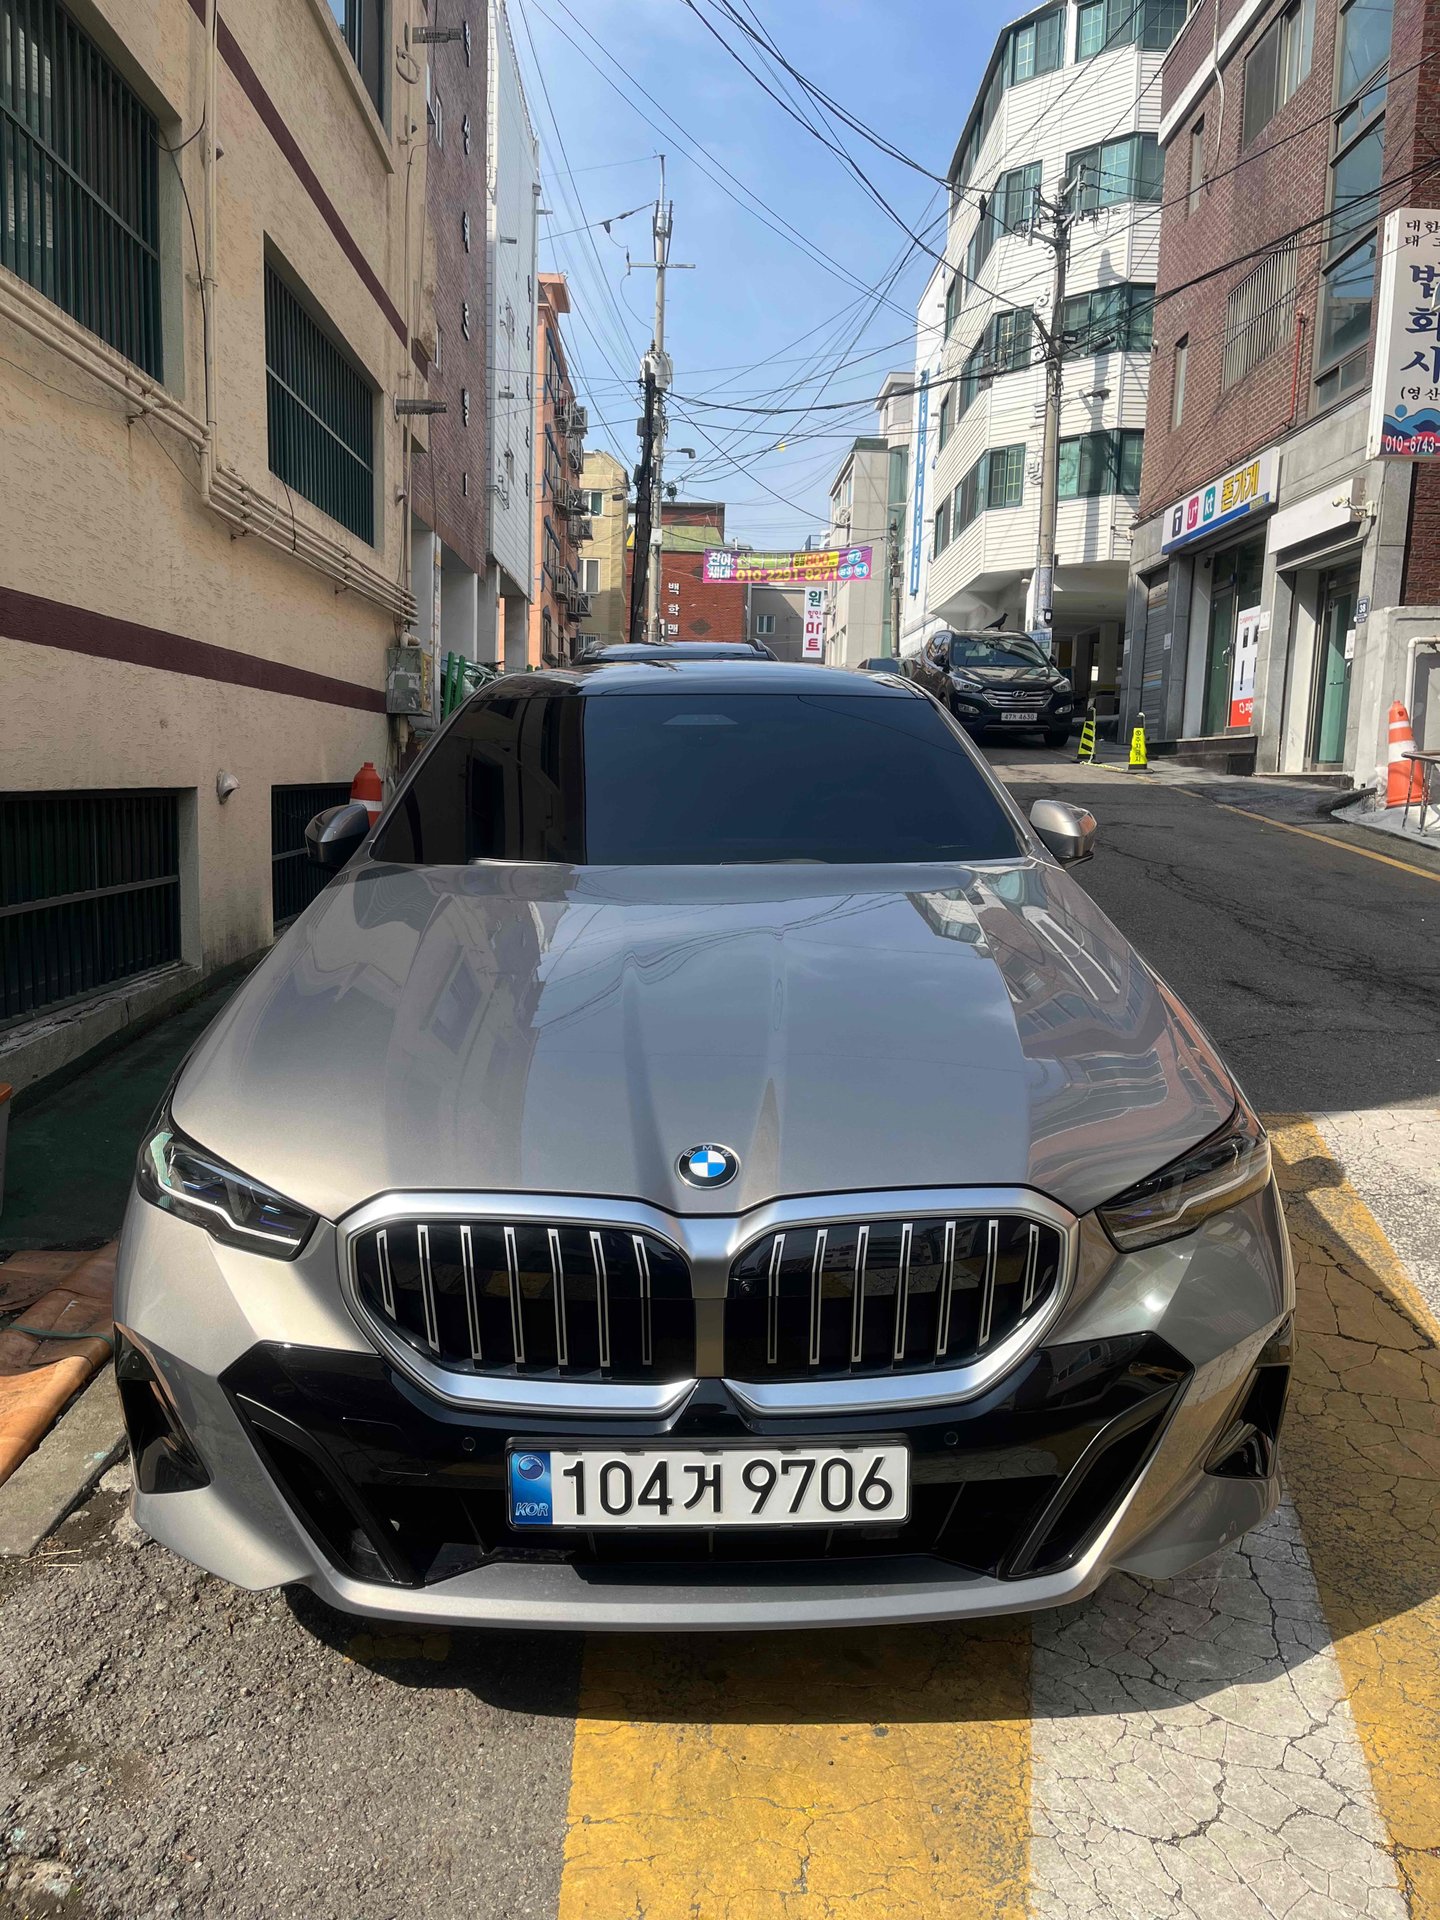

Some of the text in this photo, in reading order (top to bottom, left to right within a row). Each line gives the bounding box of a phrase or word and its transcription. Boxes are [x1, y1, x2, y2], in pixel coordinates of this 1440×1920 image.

[1221, 459, 1260, 513] 폰가게
[809, 591, 821, 607] 원
[806, 622, 822, 651] 마트
[563, 1456, 893, 1516] 104거 9706
[515, 1502, 548, 1517] KOR
